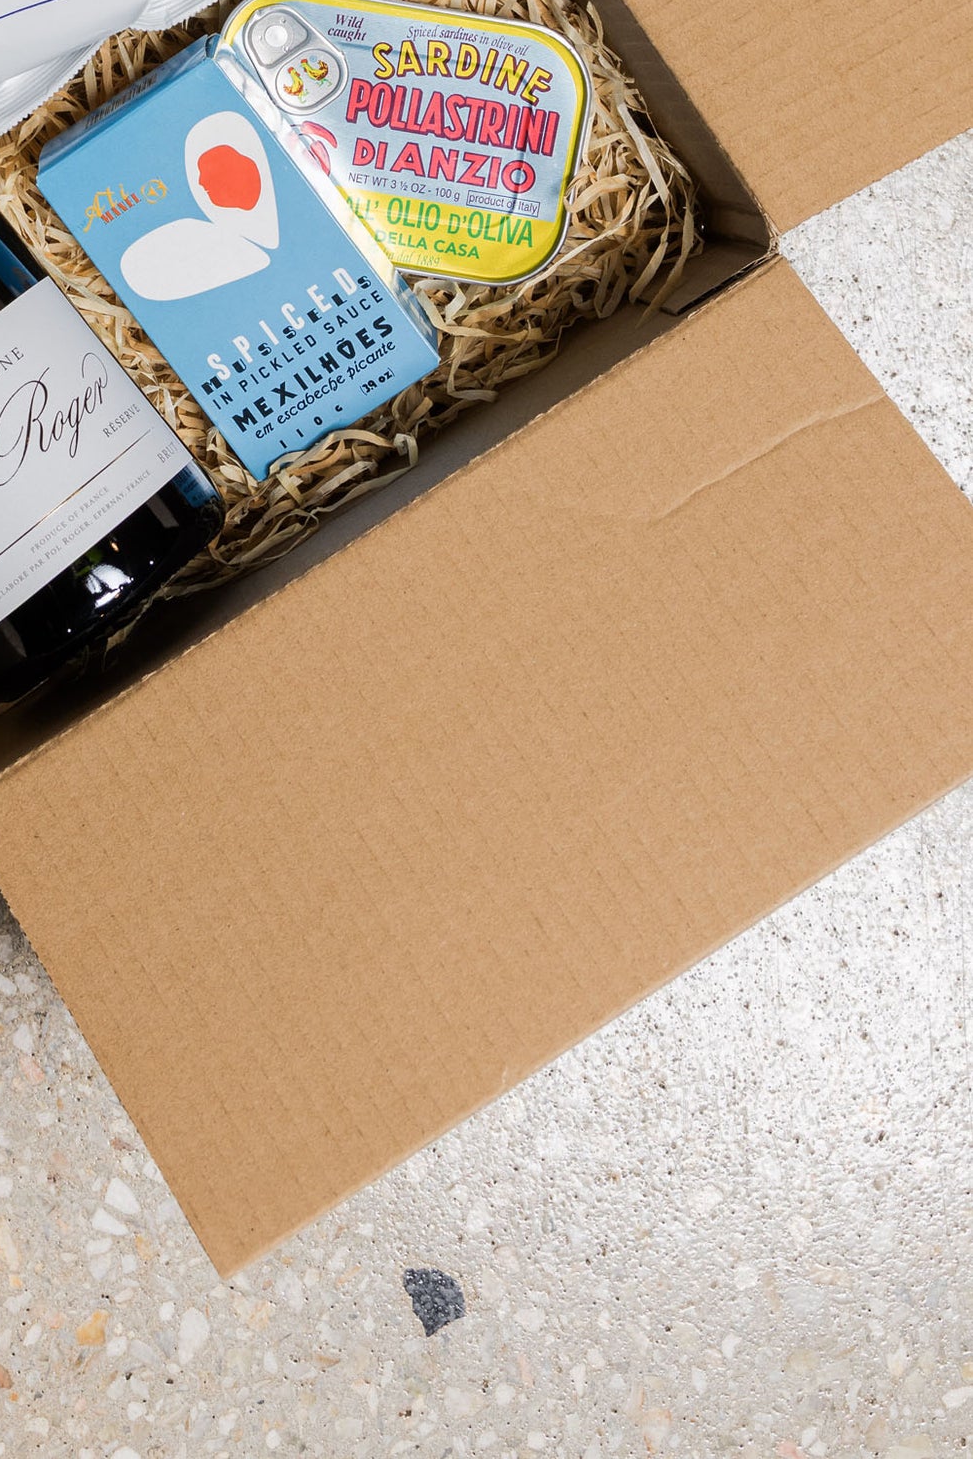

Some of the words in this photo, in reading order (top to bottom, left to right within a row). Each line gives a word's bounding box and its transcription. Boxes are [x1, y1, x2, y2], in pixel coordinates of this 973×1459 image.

[327, 27, 367, 41] caught
[335, 14, 364, 29] Wild
[407, 25, 437, 40] Spiced
[438, 26, 478, 42] sardines
[479, 35, 490, 45] in
[491, 36, 513, 52] olive
[515, 43, 530, 57] oil
[372, 39, 553, 105] SARDINE
[345, 78, 561, 158] POLLASTRINI
[348, 172, 369, 185] NET
[373, 176, 389, 189] WT
[390, 179, 397, 188] 3
[410, 183, 426, 194] OZ
[435, 187, 452, 198] 100
[453, 192, 461, 202] g
[352, 138, 389, 171] DI
[390, 142, 536, 194] ANZIO
[387, 197, 441, 231] OLIO
[447, 211, 534, 248] D'OLIVA
[468, 192, 505, 209] product
[506, 197, 515, 209] of
[517, 200, 539, 216] Italy
[374, 229, 428, 250] DELLA
[434, 239, 480, 260] CASA
[417, 253, 441, 267] 1889
[201, 275, 372, 395] MUSSELS
[207, 267, 358, 381] SPICED
[213, 391, 233, 410] IN
[238, 334, 317, 393] PICKLED
[323, 290, 383, 334] SAUCE
[232, 315, 393, 433] MEXILHÕES
[256, 424, 274, 439] em
[277, 373, 346, 425] escabeche
[347, 341, 396, 380] picante
